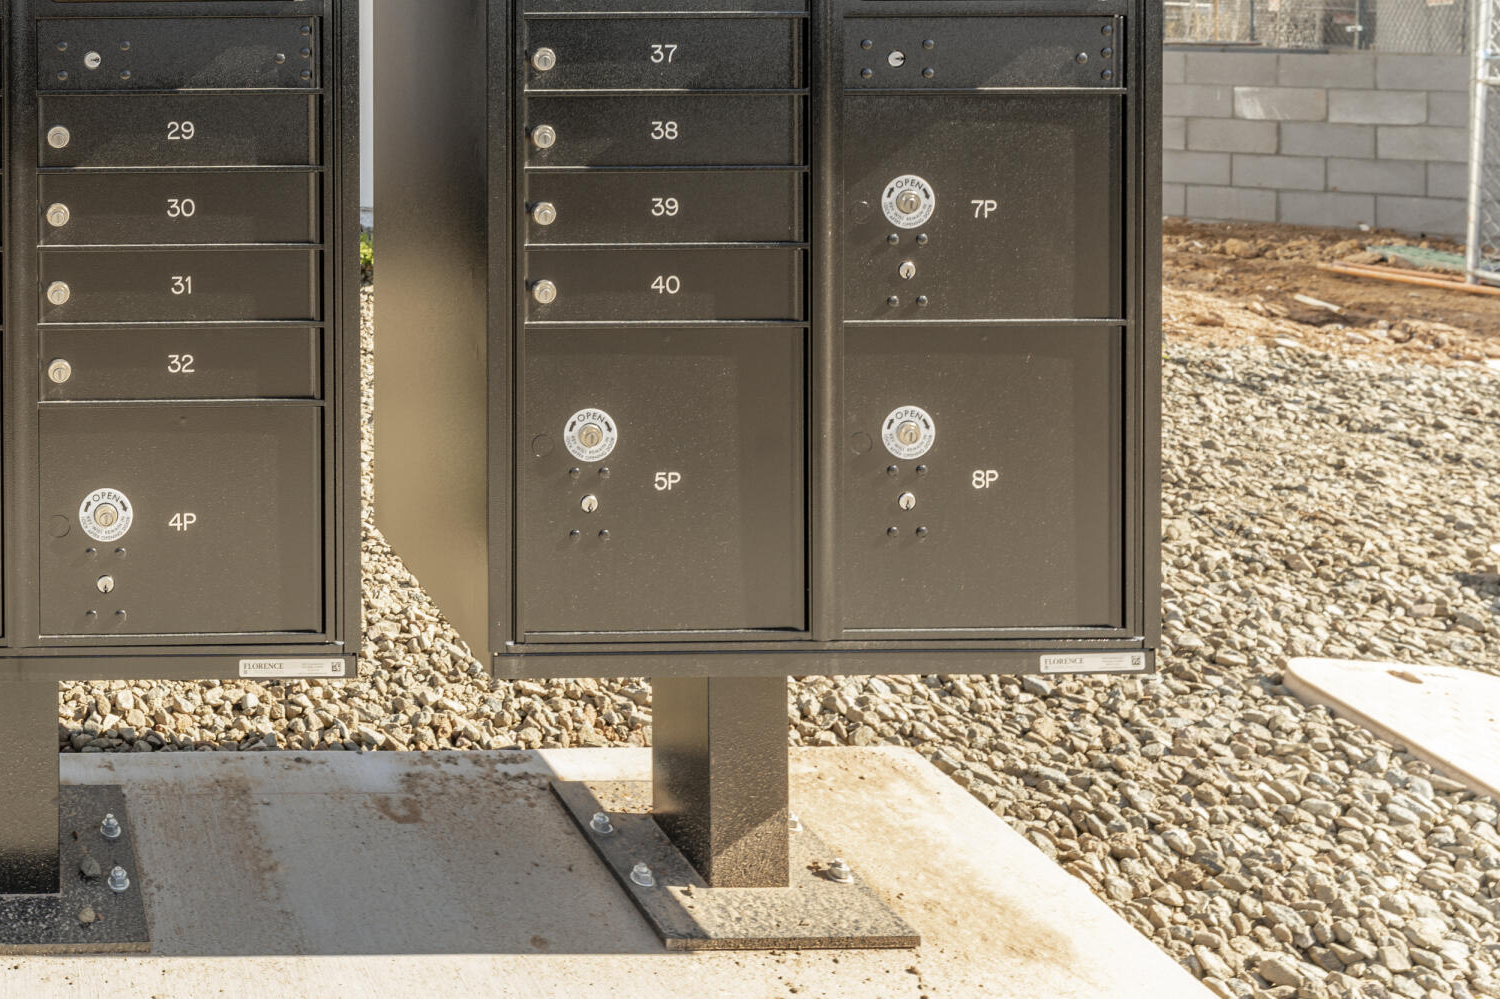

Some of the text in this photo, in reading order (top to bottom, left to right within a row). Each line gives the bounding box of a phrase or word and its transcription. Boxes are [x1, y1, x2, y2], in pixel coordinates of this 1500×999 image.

[650, 44, 678, 64] 37
[167, 120, 195, 140] 29
[650, 120, 679, 140] 38
[895, 178, 924, 189] OPEN
[166, 198, 196, 218] 30
[651, 197, 679, 217] 39
[970, 199, 998, 219] 7P
[170, 275, 192, 295] 31
[650, 275, 681, 295] 40
[167, 354, 195, 374] 32
[577, 412, 605, 423] OPEN
[895, 409, 923, 420] OPEN
[654, 471, 682, 491] 5P
[971, 469, 999, 490] 8P
[92, 492, 121, 502] OPEN
[168, 512, 197, 532] 4P
[243, 662, 284, 670] FLORENCE
[1044, 656, 1085, 665] FLORENCE
